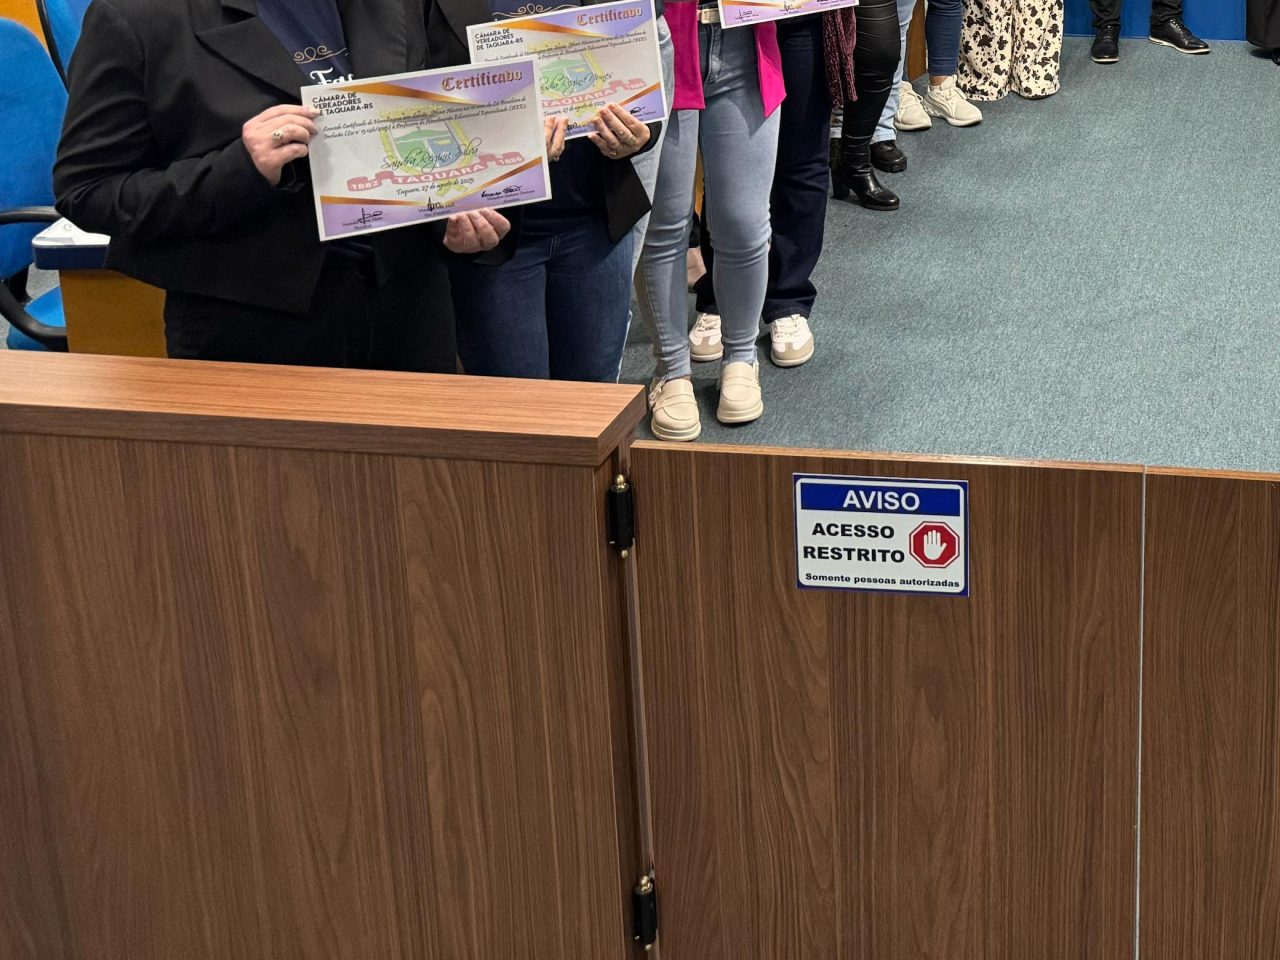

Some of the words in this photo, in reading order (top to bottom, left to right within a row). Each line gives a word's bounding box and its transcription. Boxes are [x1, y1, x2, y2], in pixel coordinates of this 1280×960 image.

[576, 6, 643, 27] Certificado
[441, 70, 523, 92] Certificado
[313, 98, 361, 109] VEREADORES
[542, 89, 612, 107] TAQUARA
[326, 102, 374, 115] TAQUARA-RS
[393, 163, 485, 184] TAQUARA
[842, 490, 920, 512] AVISO
[811, 522, 895, 540] ACESSO
[802, 545, 906, 564] RESTRITO
[805, 572, 851, 583] Somente
[853, 576, 897, 586] pessoas
[899, 578, 960, 588] autorizadas
